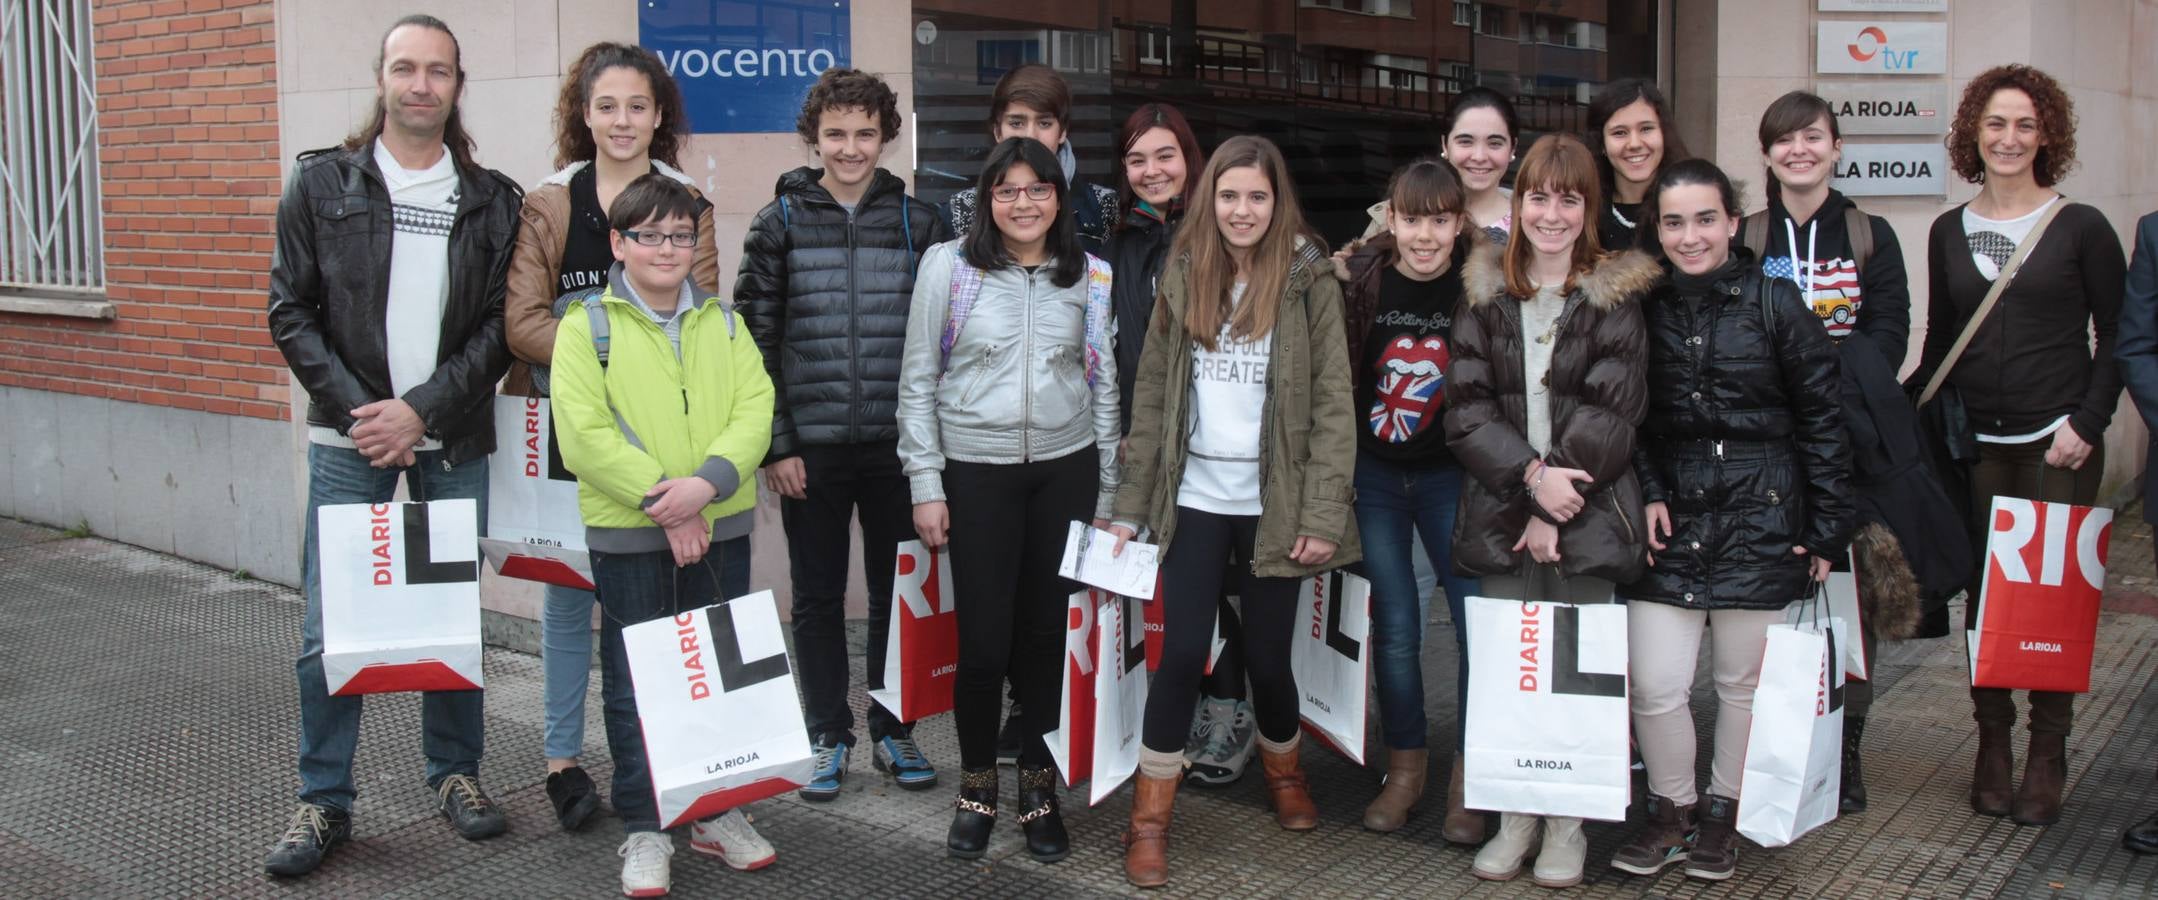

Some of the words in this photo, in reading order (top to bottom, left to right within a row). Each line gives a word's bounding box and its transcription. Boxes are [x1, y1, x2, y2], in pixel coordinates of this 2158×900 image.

[656, 48, 835, 78] vocento
[1882, 46, 1919, 70] tvr
[1830, 101, 1854, 117] LA
[1858, 101, 1918, 117] RIOJA
[1833, 162, 1861, 178] LA
[1868, 161, 1932, 178] RIOJA
[561, 269, 607, 289] DIDN'
[1191, 357, 1267, 385] CREATE
[1143, 623, 1164, 632] RIOJ
[2021, 640, 2034, 651] LA
[2035, 641, 2062, 653] RIOJA
[942, 663, 957, 674] RIOJ
[706, 763, 723, 774] LA
[724, 752, 760, 769] RIOJA
[1517, 758, 1533, 769] LA
[1535, 759, 1573, 771] RIOJA
